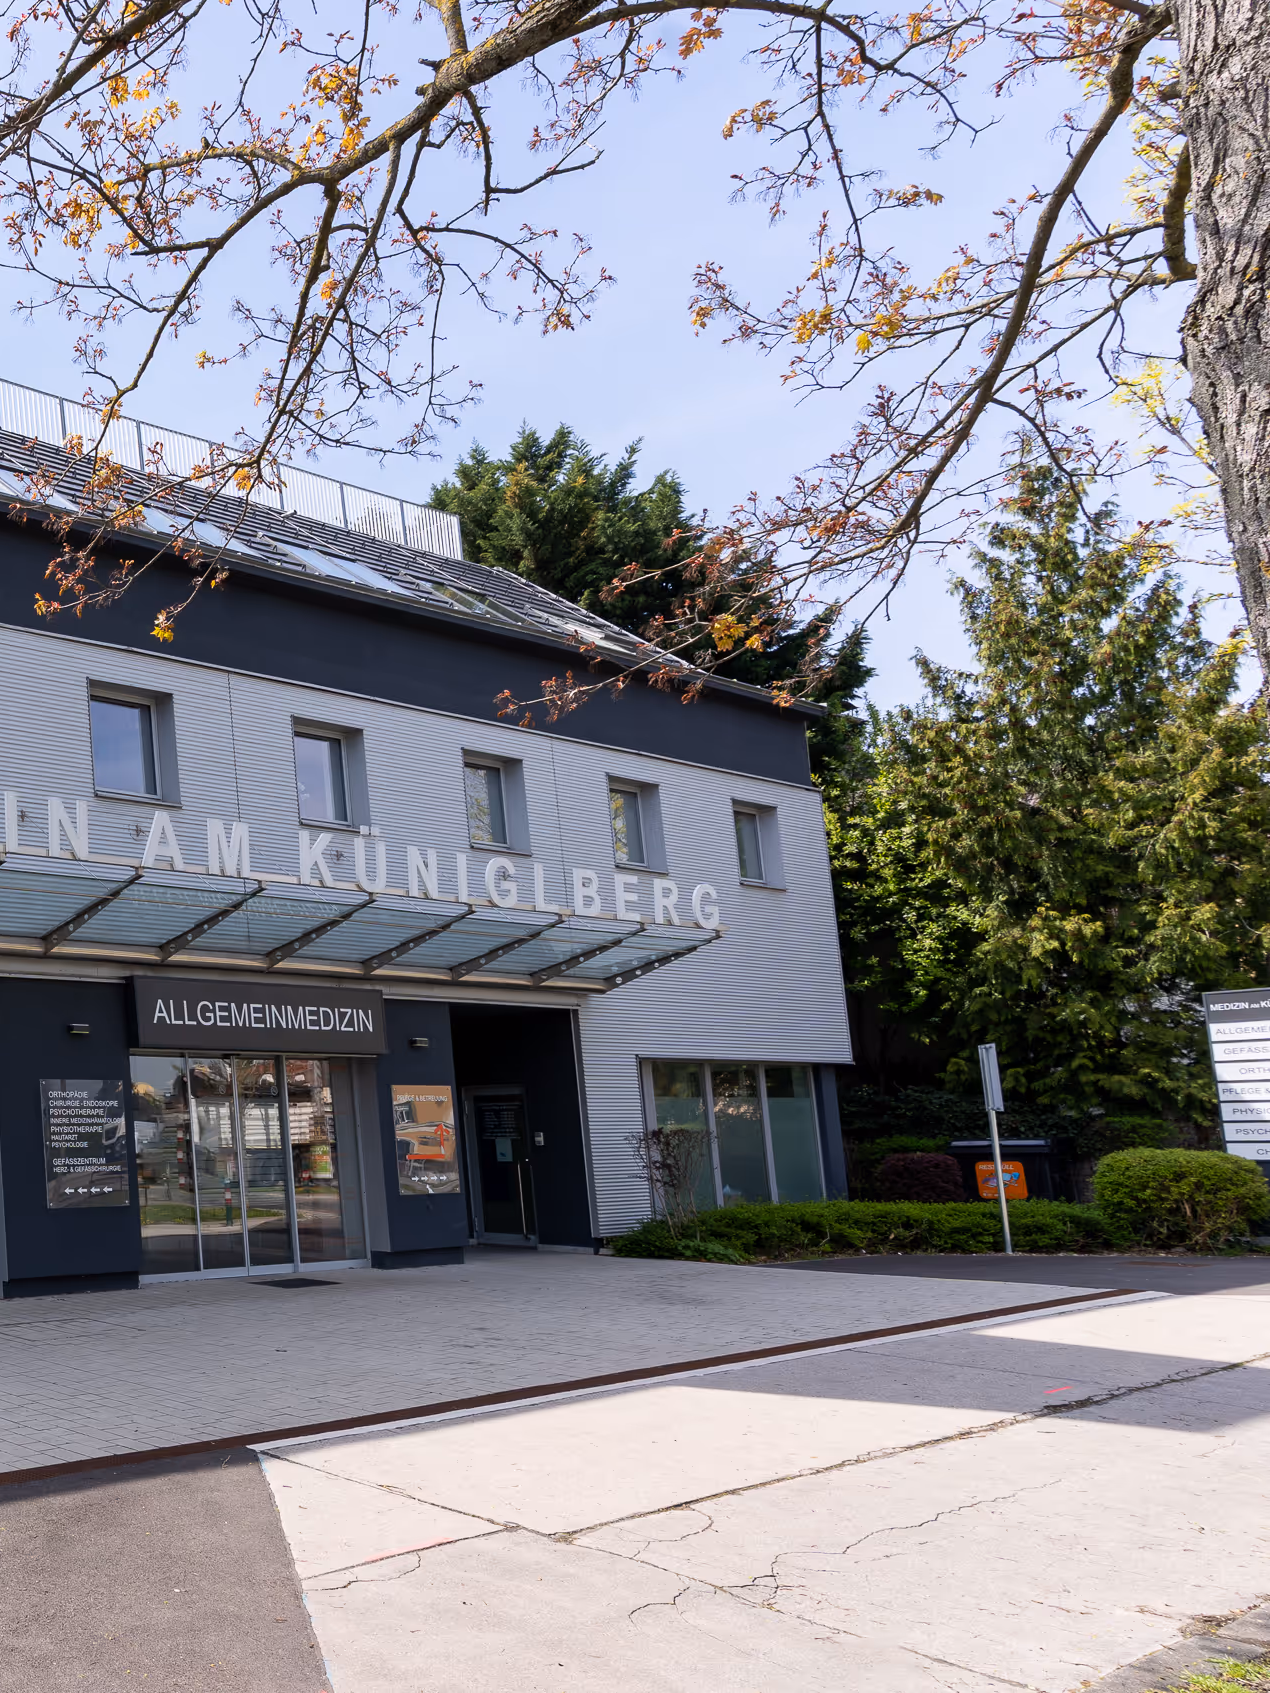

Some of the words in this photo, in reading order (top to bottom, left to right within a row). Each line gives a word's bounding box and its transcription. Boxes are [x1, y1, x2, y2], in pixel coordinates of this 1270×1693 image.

[143, 811, 250, 878] AM
[298, 825, 721, 930] KÜNIGLBERG
[153, 998, 374, 1032] ALLGEMEINMEDIZIN
[1210, 1002, 1249, 1011] MEDIZIN
